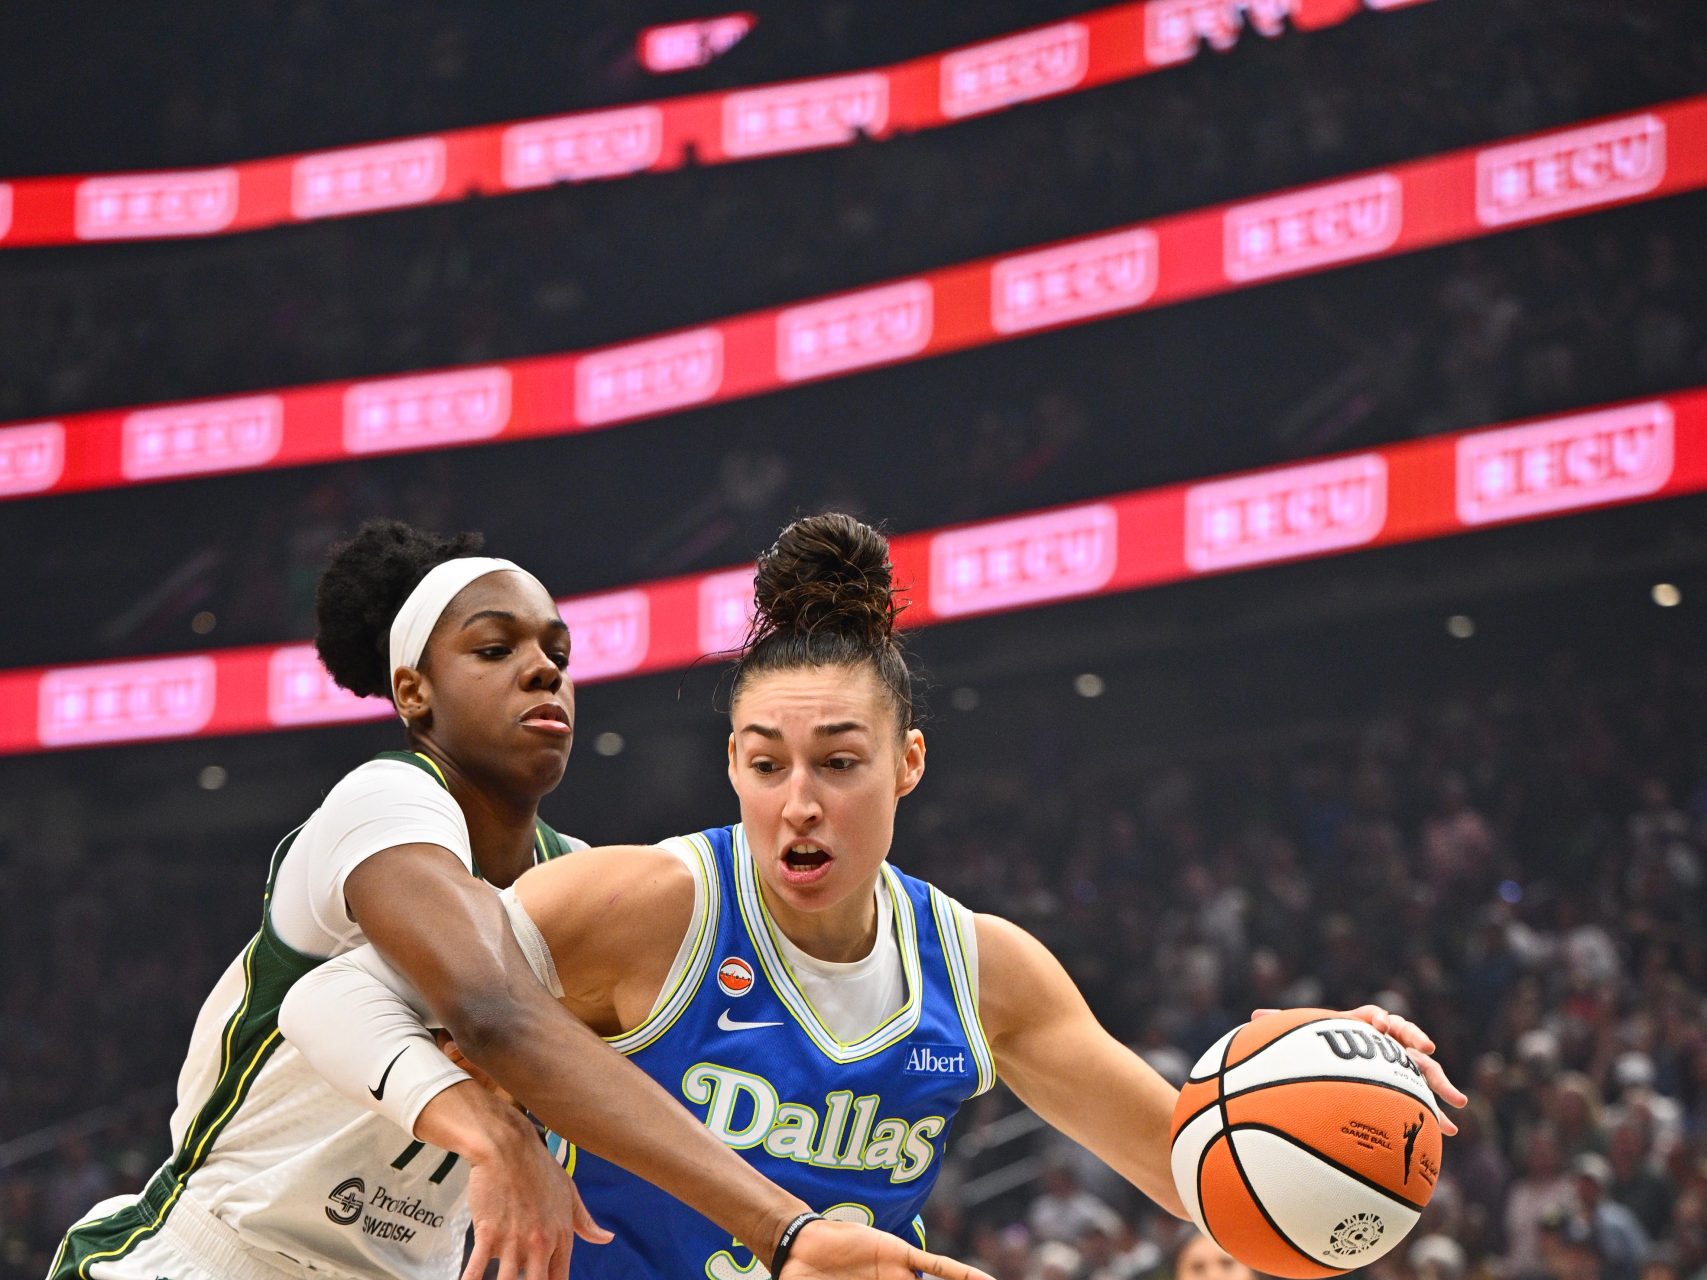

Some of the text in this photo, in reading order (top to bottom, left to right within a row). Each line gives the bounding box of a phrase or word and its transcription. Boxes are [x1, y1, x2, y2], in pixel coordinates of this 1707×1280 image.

[1006, 255, 1145, 314] BECU
[1240, 197, 1387, 262] BECU
[1492, 135, 1650, 207] BECU
[945, 530, 1100, 592] BECU
[1204, 480, 1370, 547] BECU
[1475, 429, 1656, 498] BECU
[906, 1047, 966, 1073] Albert
[681, 1062, 946, 1184] Dallas
[1350, 1120, 1390, 1139] OFFICIAL
[1341, 1127, 1392, 1150] GAME BALL
[363, 1215, 416, 1244] SWEDISH
